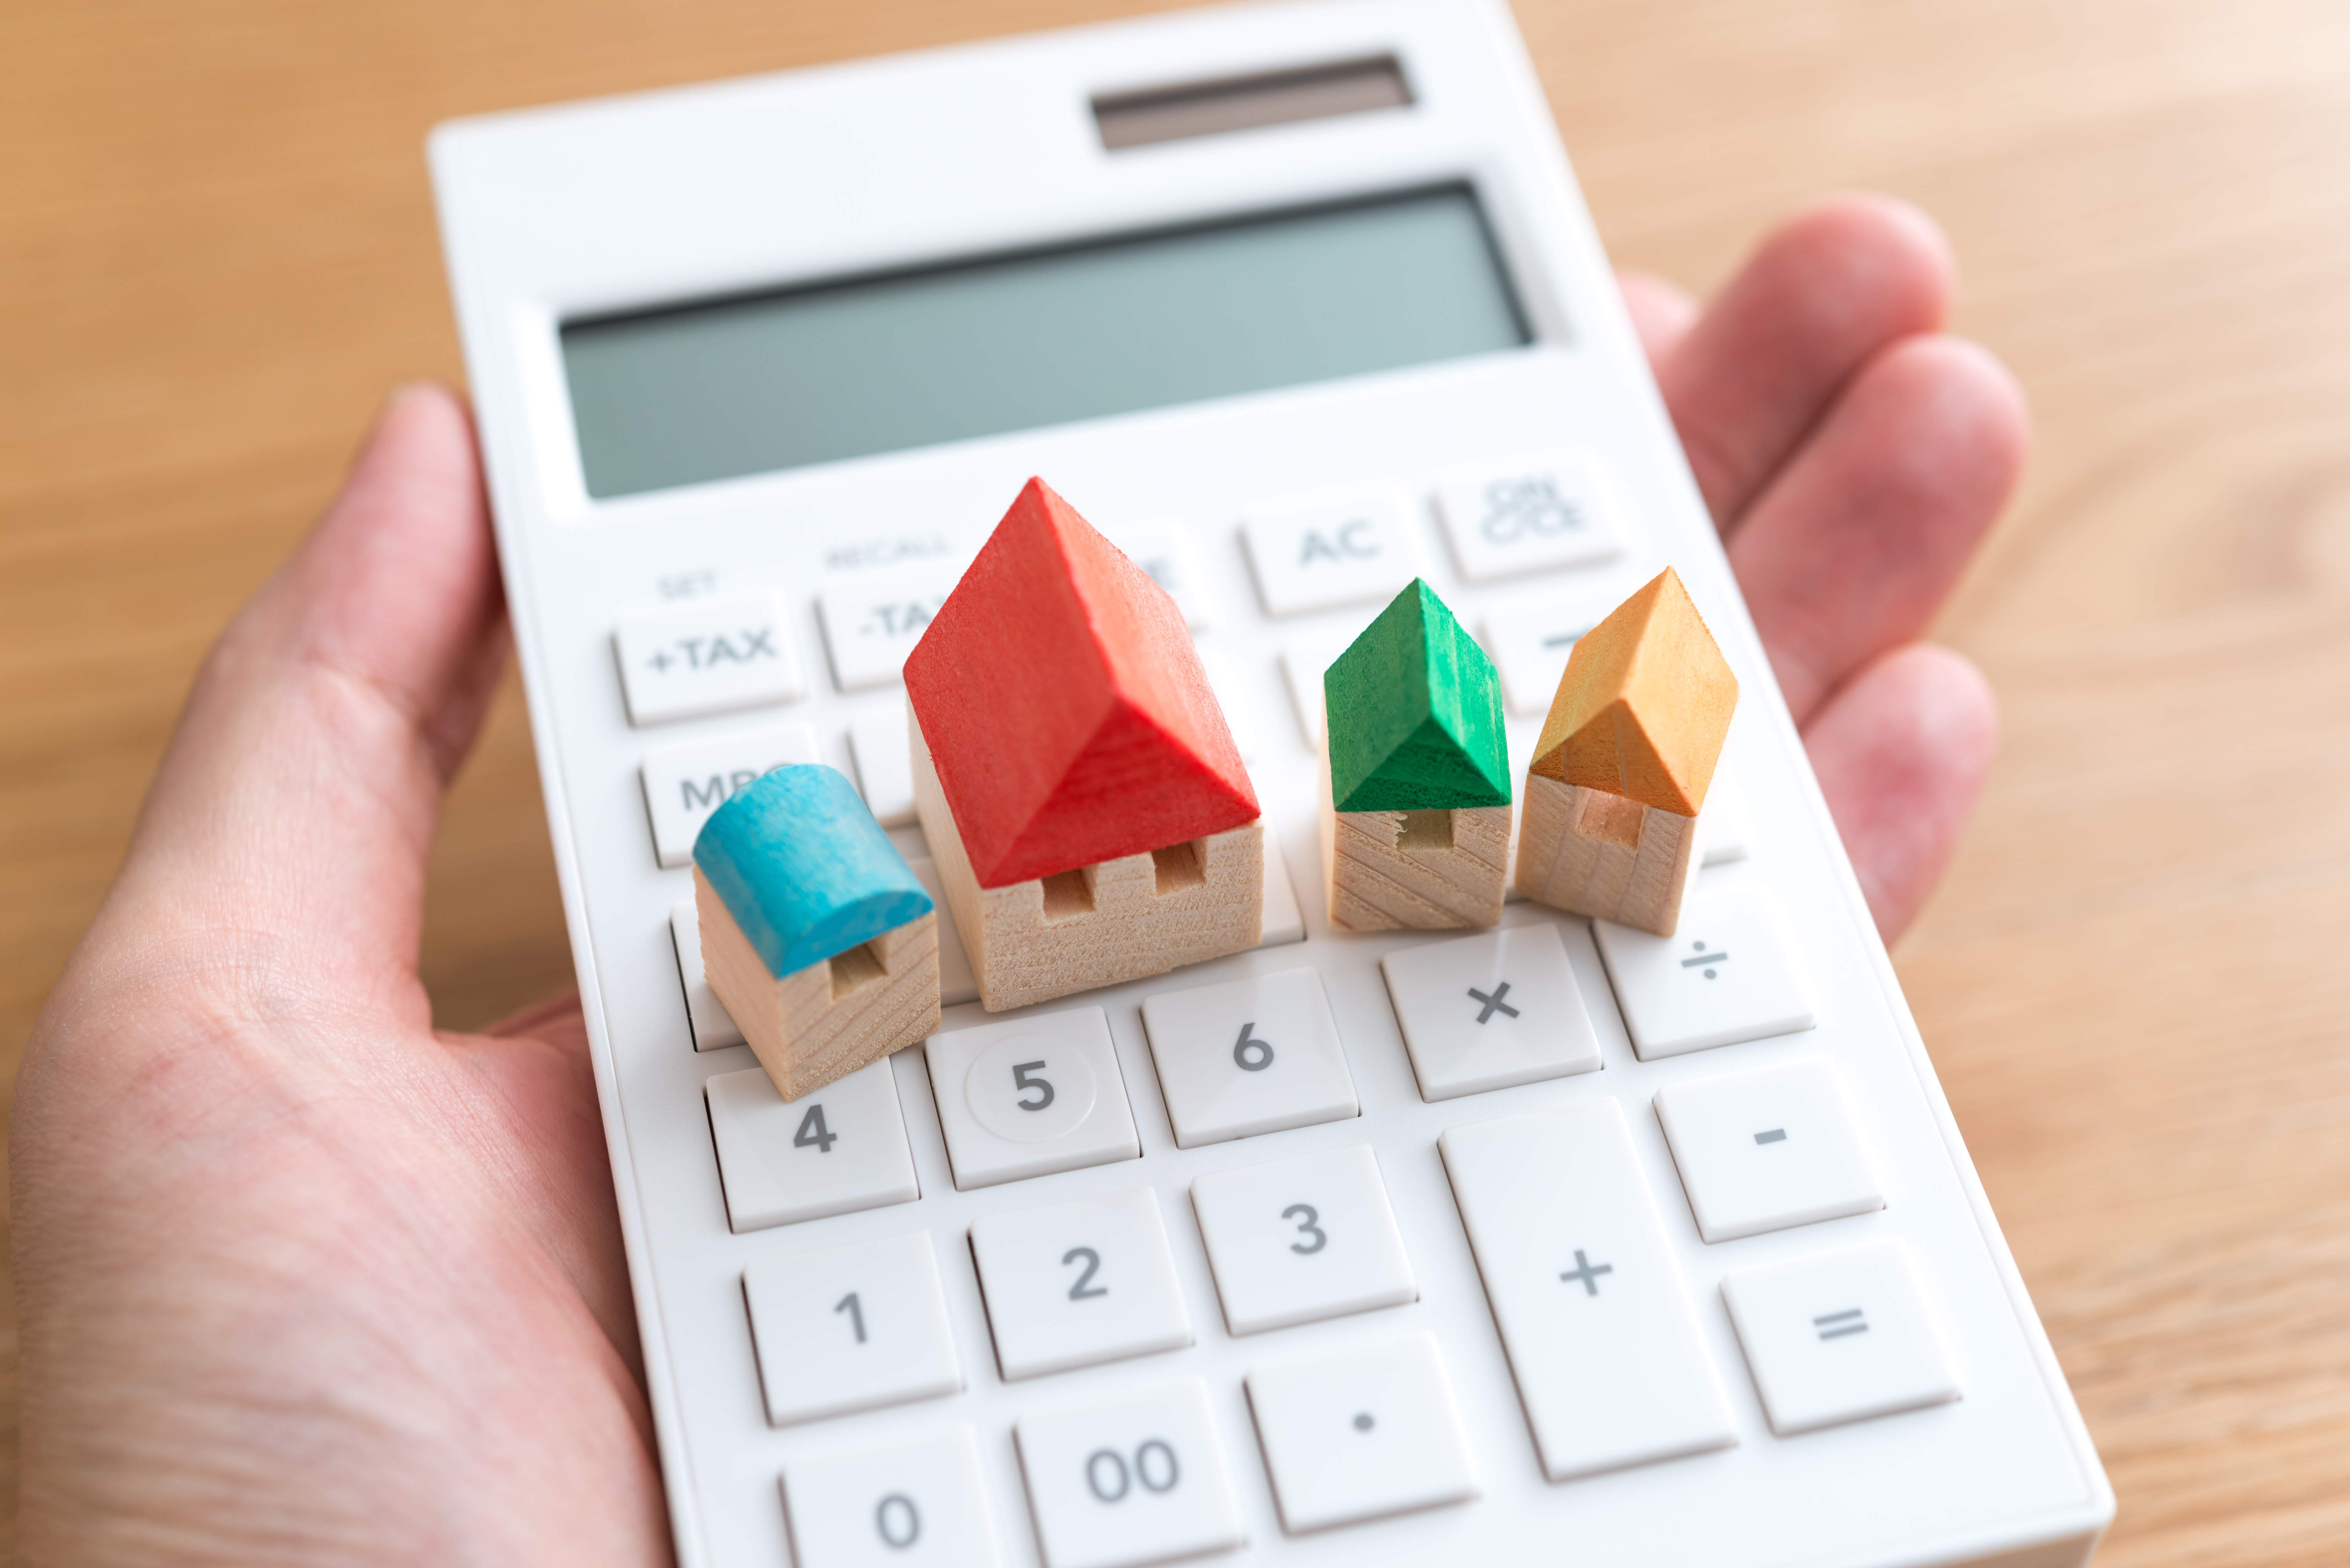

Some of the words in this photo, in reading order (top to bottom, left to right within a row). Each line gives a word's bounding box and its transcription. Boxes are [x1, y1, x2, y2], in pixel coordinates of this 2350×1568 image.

[824, 530, 952, 572] RECALL
[1298, 520, 1379, 566] AC
[657, 569, 716, 601] SET
[860, 596, 944, 639] -TA
[647, 627, 777, 673] +TAX
[1233, 1022, 1274, 1072] 6
[1012, 1060, 1055, 1112] 5
[794, 1106, 838, 1153] 4
[1281, 1203, 1327, 1256] 3
[1061, 1246, 1108, 1302] 2
[833, 1291, 868, 1344] 1
[1083, 1438, 1181, 1505] 00
[874, 1492, 922, 1552] 0
